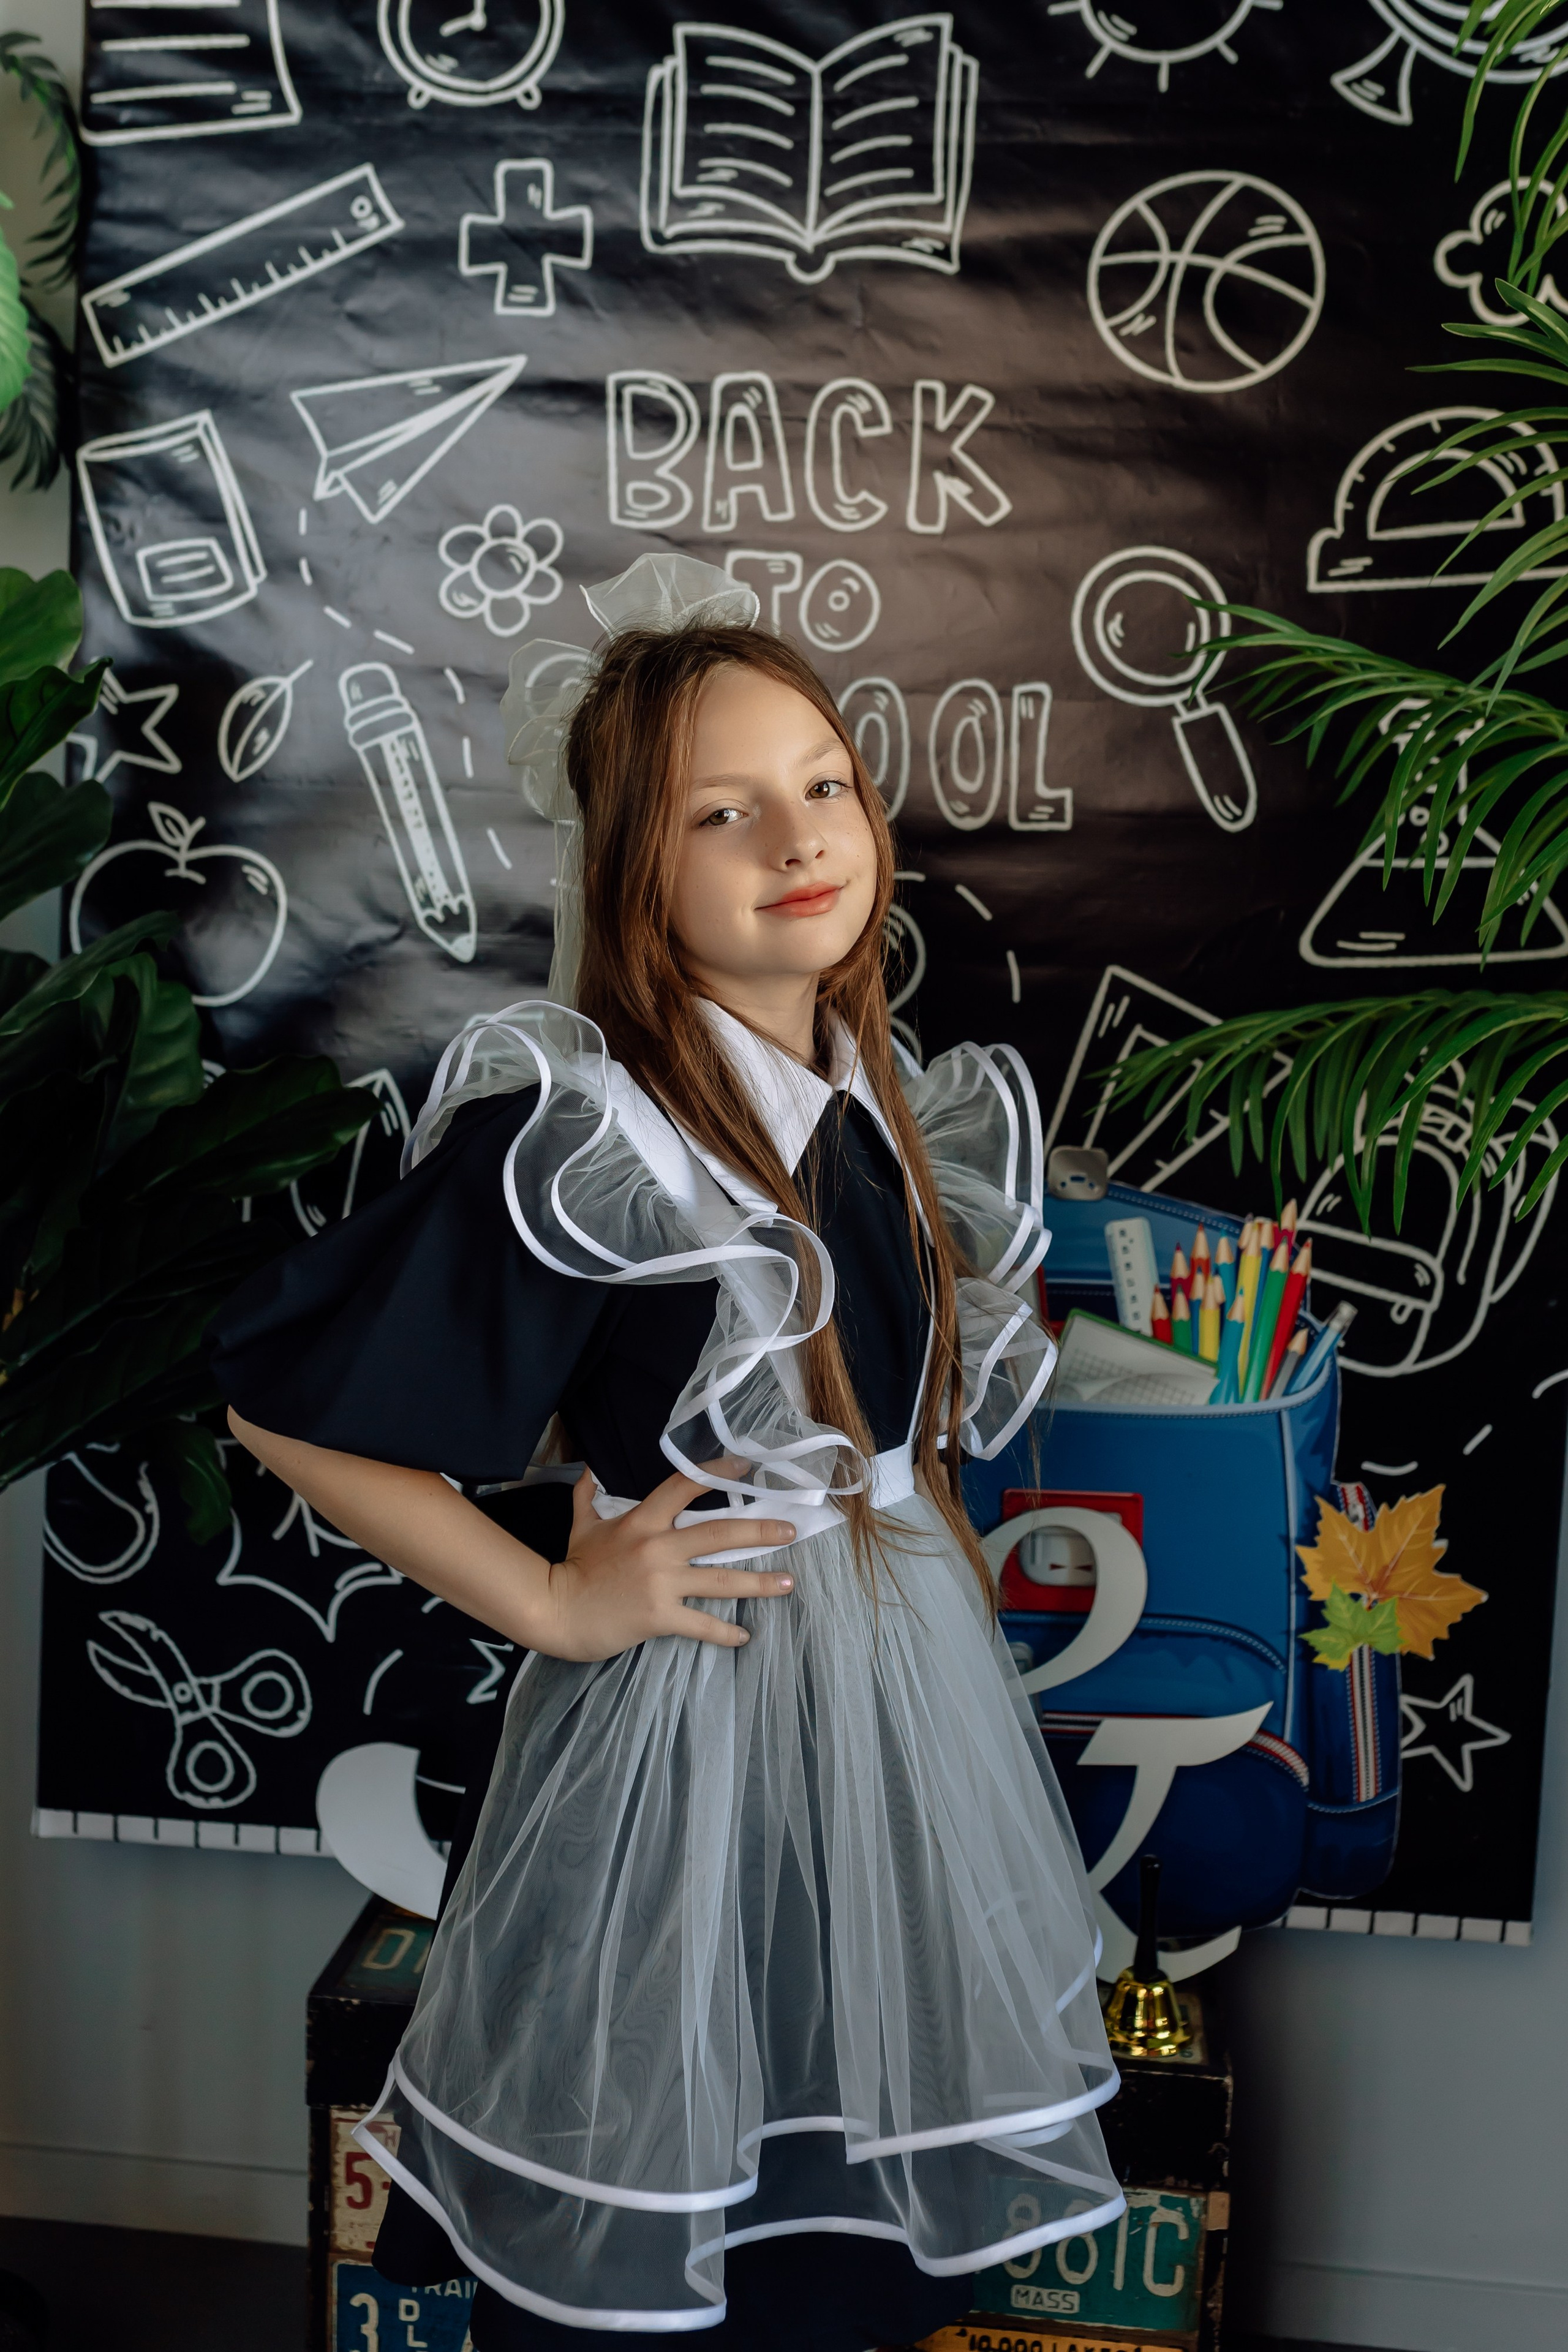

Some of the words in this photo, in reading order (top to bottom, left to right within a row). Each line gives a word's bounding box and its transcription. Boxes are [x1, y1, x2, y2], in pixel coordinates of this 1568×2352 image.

[606, 370, 1012, 533] BACK
[725, 551, 881, 652] TO
[1014, 2288, 1076, 2312] MASS
